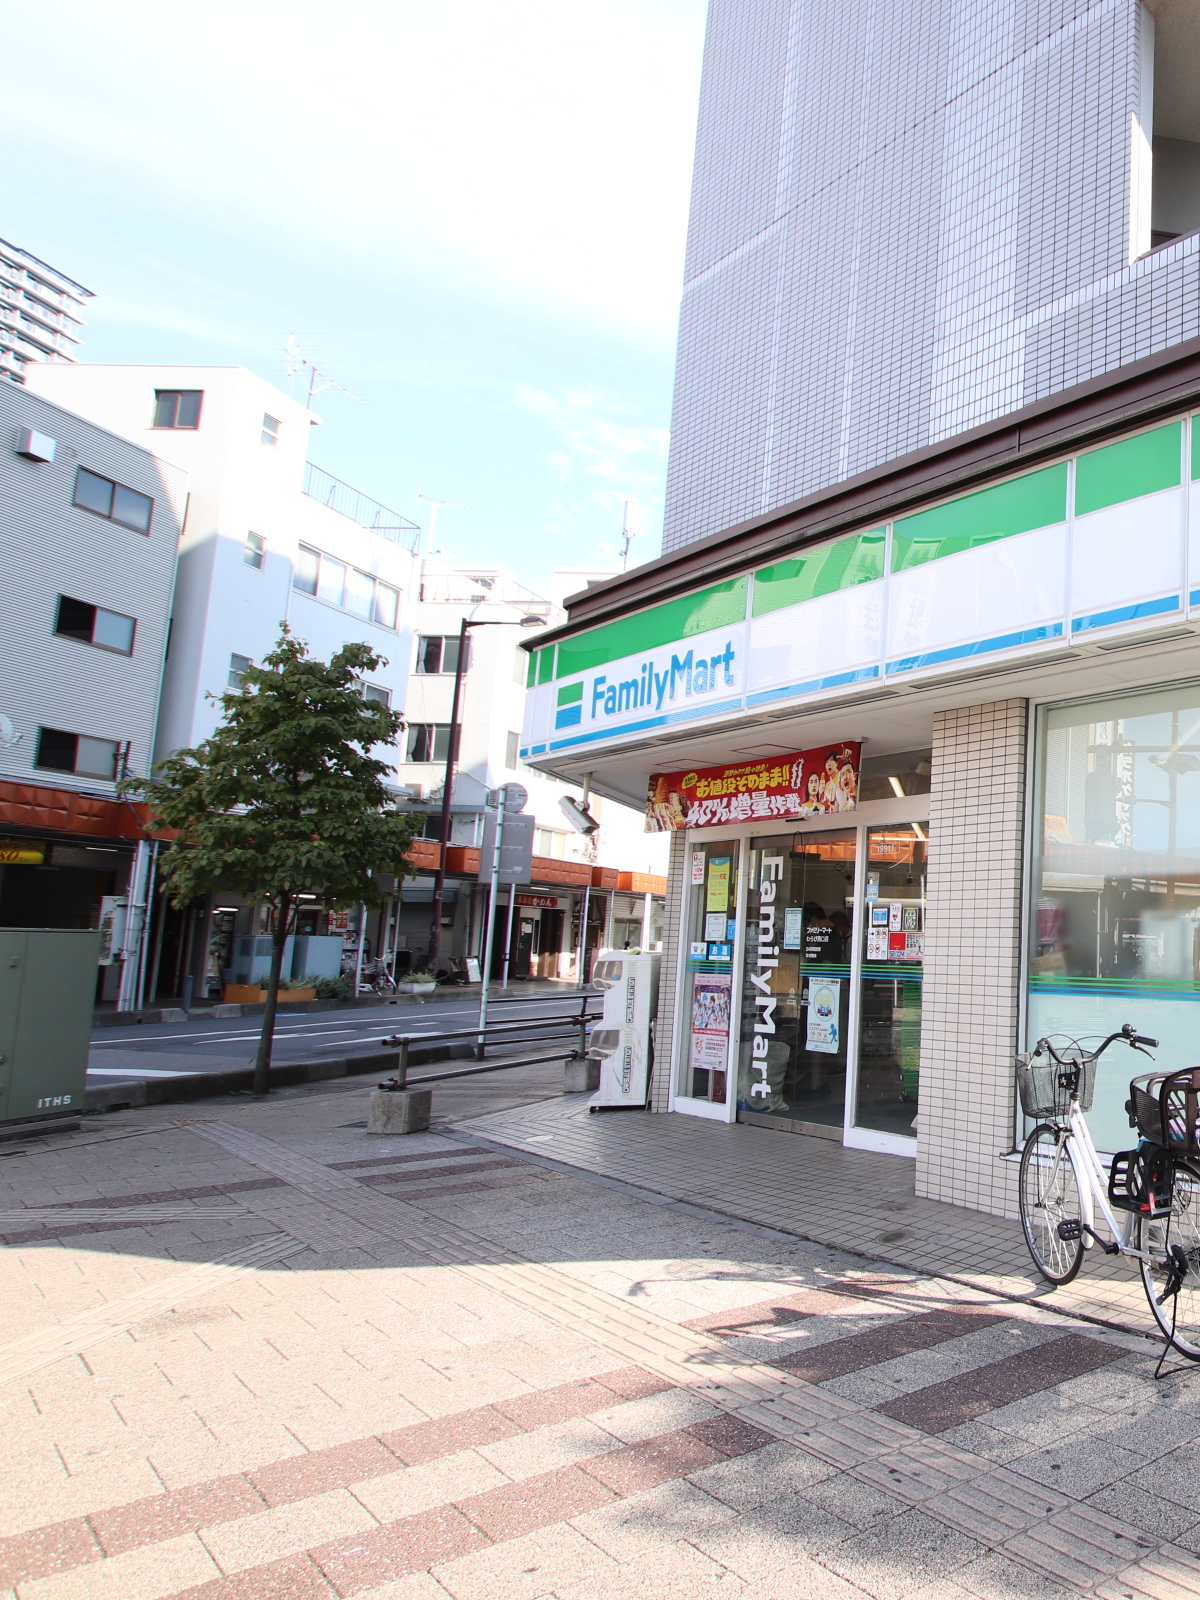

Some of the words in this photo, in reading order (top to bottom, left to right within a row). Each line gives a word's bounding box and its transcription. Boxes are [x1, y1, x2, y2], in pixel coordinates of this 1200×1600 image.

[591, 640, 735, 719] FamilyMart
[696, 765, 791, 798] お値段そのまま!!
[877, 845, 895, 853] 19911
[532, 897, 552, 907] かのん
[751, 856, 783, 1098] FamilyMart
[37, 1095, 72, 1108] ITHS
